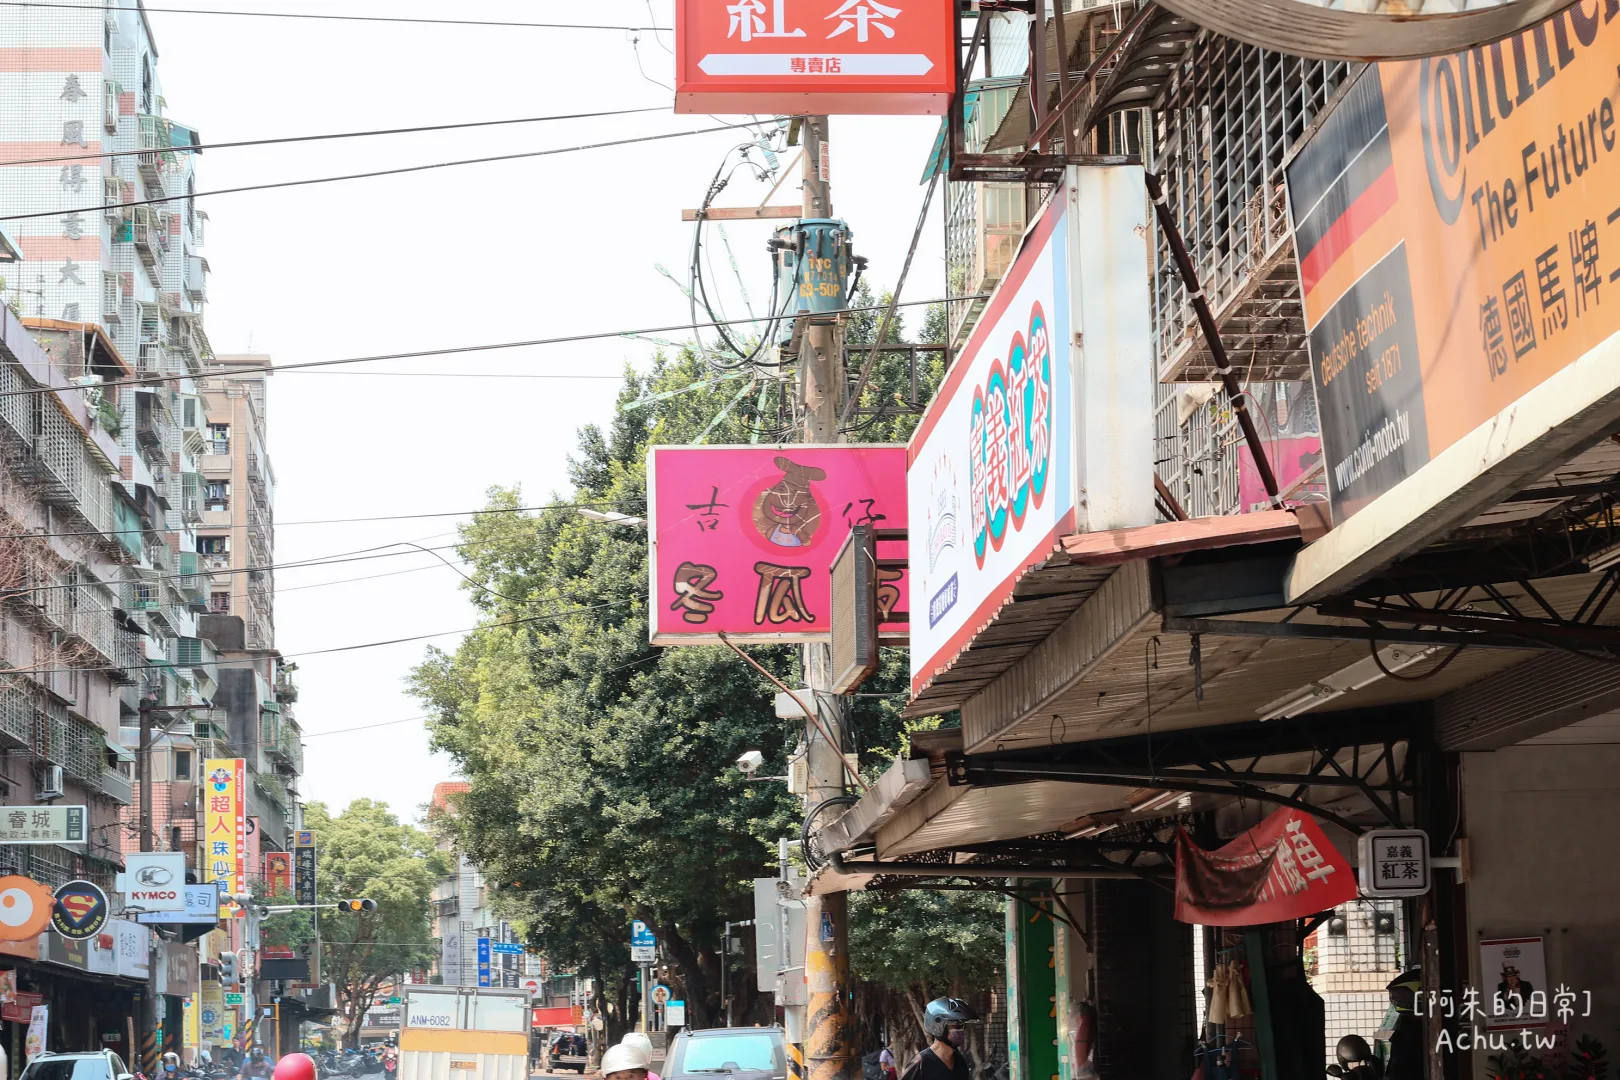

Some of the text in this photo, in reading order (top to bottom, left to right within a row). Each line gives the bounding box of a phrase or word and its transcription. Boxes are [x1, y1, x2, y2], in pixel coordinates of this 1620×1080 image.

[790, 57, 842, 73] 專賣店
[1471, 96, 1616, 251] The Future
[1320, 290, 1397, 387] deutsche technik
[1365, 343, 1402, 395] seit 1871
[970, 327, 1048, 544] 嘉義紅茶
[1334, 408, 1411, 492] www.conti-moto.tw
[685, 485, 730, 532] 吉
[8, 810, 51, 829] 睿城
[1386, 845, 1413, 858] 嘉義
[1381, 862, 1419, 880] 紅茶
[131, 890, 177, 900] KYMCO
[410, 1014, 451, 1027] ANM-6082
